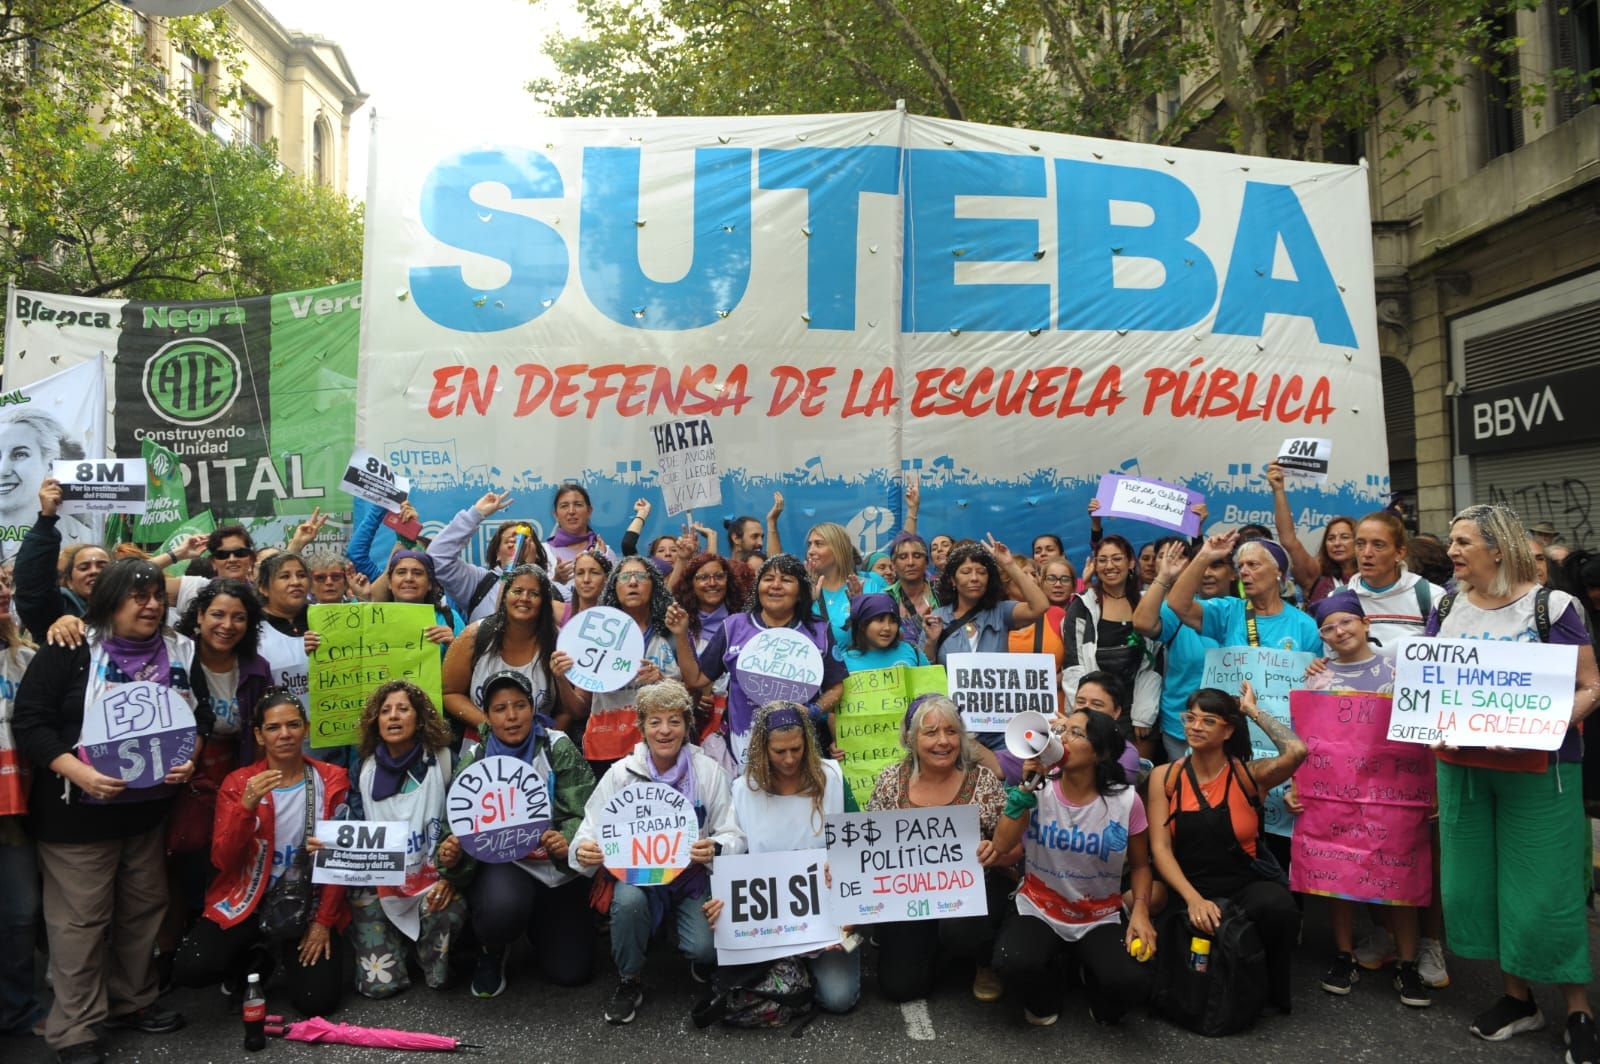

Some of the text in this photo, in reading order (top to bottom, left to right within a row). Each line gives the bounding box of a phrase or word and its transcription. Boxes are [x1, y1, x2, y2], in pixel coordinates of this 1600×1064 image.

[409, 144, 1359, 349] SUTEBA
[16, 296, 112, 328] Blanca
[143, 306, 247, 333] Negra
[158, 352, 224, 411] ATE
[427, 357, 1336, 425] EN DEFENSA DE LA ESCUELA PÚBLICA
[1474, 385, 1564, 440] BBVA
[134, 425, 246, 443] Construyendo
[654, 420, 713, 455] HARTA
[174, 441, 228, 456] Unidad
[390, 449, 451, 466] SUTEBA
[1288, 440, 1318, 457] 8M
[76, 463, 124, 482] 8M
[366, 457, 396, 485] 8M
[756, 634, 810, 659] BASTA
[1405, 643, 1479, 664] CONTRA
[611, 657, 632, 672] 8M
[1222, 652, 1248, 667] CHE
[319, 670, 390, 689] HAMBRE
[744, 674, 809, 701] SUTEBA
[956, 669, 1049, 690] BASTA DE
[1206, 667, 1253, 686] Marcho
[1422, 666, 1532, 686] EL HAMBRE
[838, 700, 868, 715] POR
[952, 691, 1054, 714] CRUELDAD
[1338, 699, 1376, 724] 8M
[1398, 687, 1551, 714] 8M EL SAQUEO
[840, 721, 900, 739] LABORAL
[1437, 711, 1568, 736] LA CRUELDAD
[170, 731, 197, 766] SUTEBA
[605, 787, 685, 814] VIOLENCIA
[636, 805, 652, 818] EN
[336, 824, 386, 849] 8M
[602, 813, 686, 838] EL TRABAJO
[896, 817, 957, 843] PARA
[1028, 808, 1099, 855] Suteba
[474, 828, 540, 852] SUTEBA
[605, 842, 619, 855] 8M
[632, 831, 682, 866] NO!
[333, 850, 389, 861] En defensa de las
[731, 862, 820, 923] ESI SÍ
[840, 869, 975, 898] DE IGUALDAD
[907, 899, 930, 917] 8M
